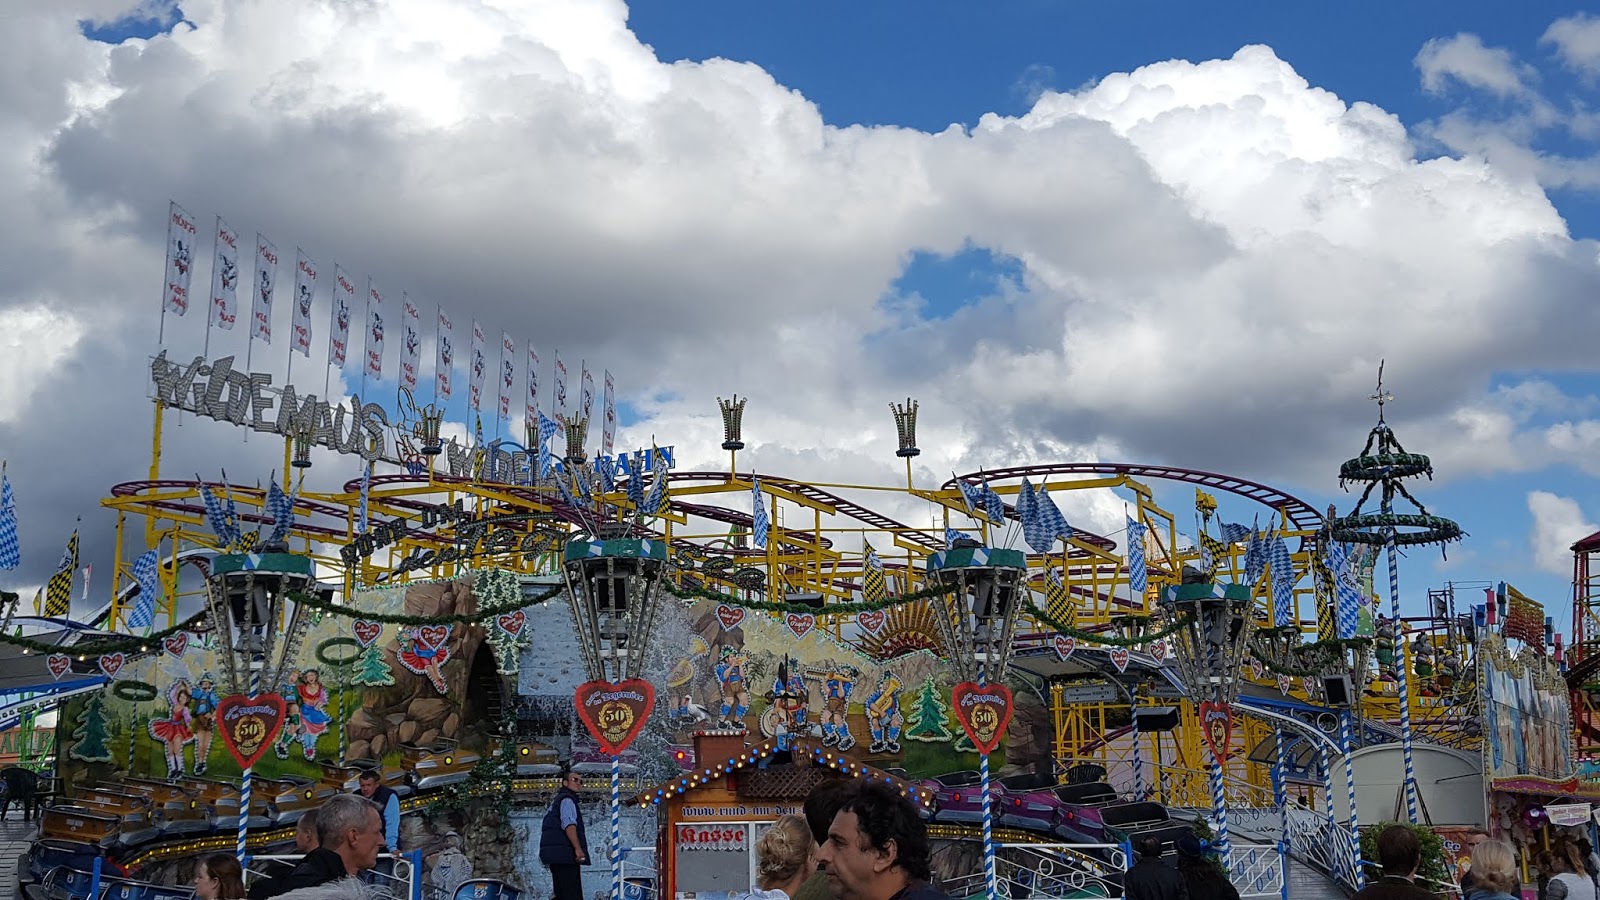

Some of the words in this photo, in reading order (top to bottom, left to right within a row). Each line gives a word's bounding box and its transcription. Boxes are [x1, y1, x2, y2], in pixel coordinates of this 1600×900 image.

[276, 384, 388, 462] MAUS
[421, 499, 468, 530] UM
[601, 690, 644, 701] Tegernsee
[605, 709, 625, 721] 50
[976, 711, 991, 723] 50
[240, 723, 258, 735] 50
[680, 826, 744, 844] Kasse
